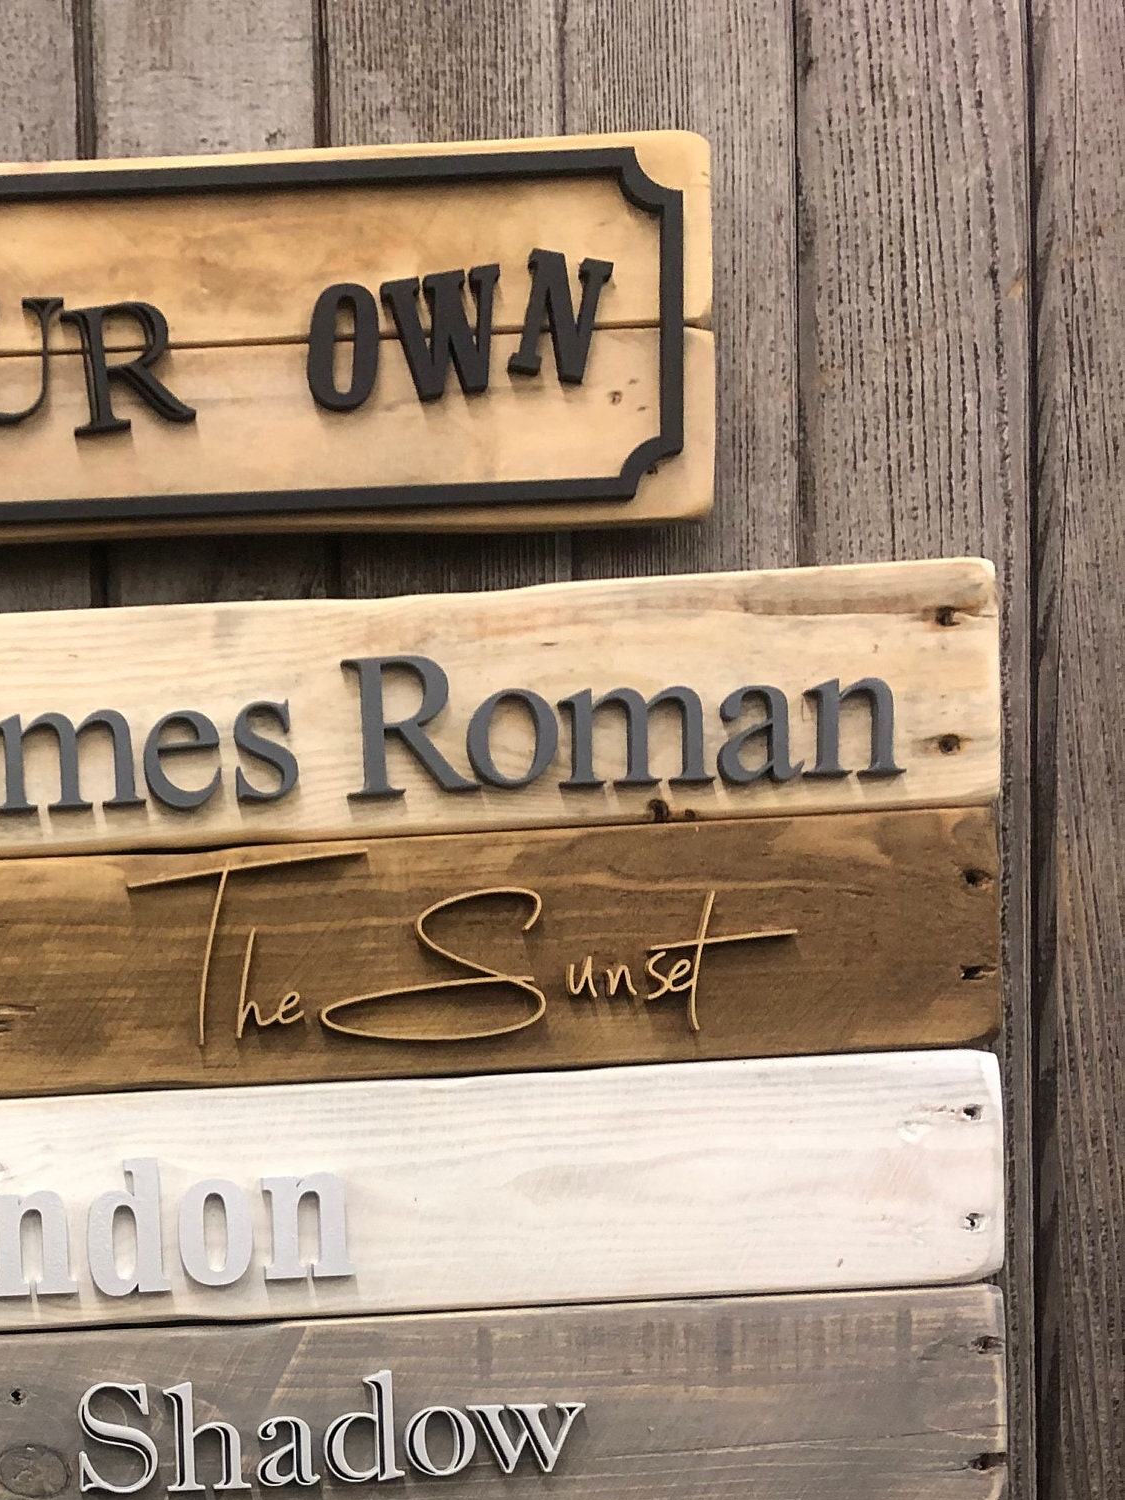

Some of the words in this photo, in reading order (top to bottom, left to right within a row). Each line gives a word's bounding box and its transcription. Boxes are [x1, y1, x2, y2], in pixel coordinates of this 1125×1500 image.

[307, 247, 613, 412] OWN
[340, 653, 906, 801] Roman
[126, 849, 367, 1047] The
[320, 886, 798, 1040] Sunset
[77, 1369, 586, 1494] Shadow
